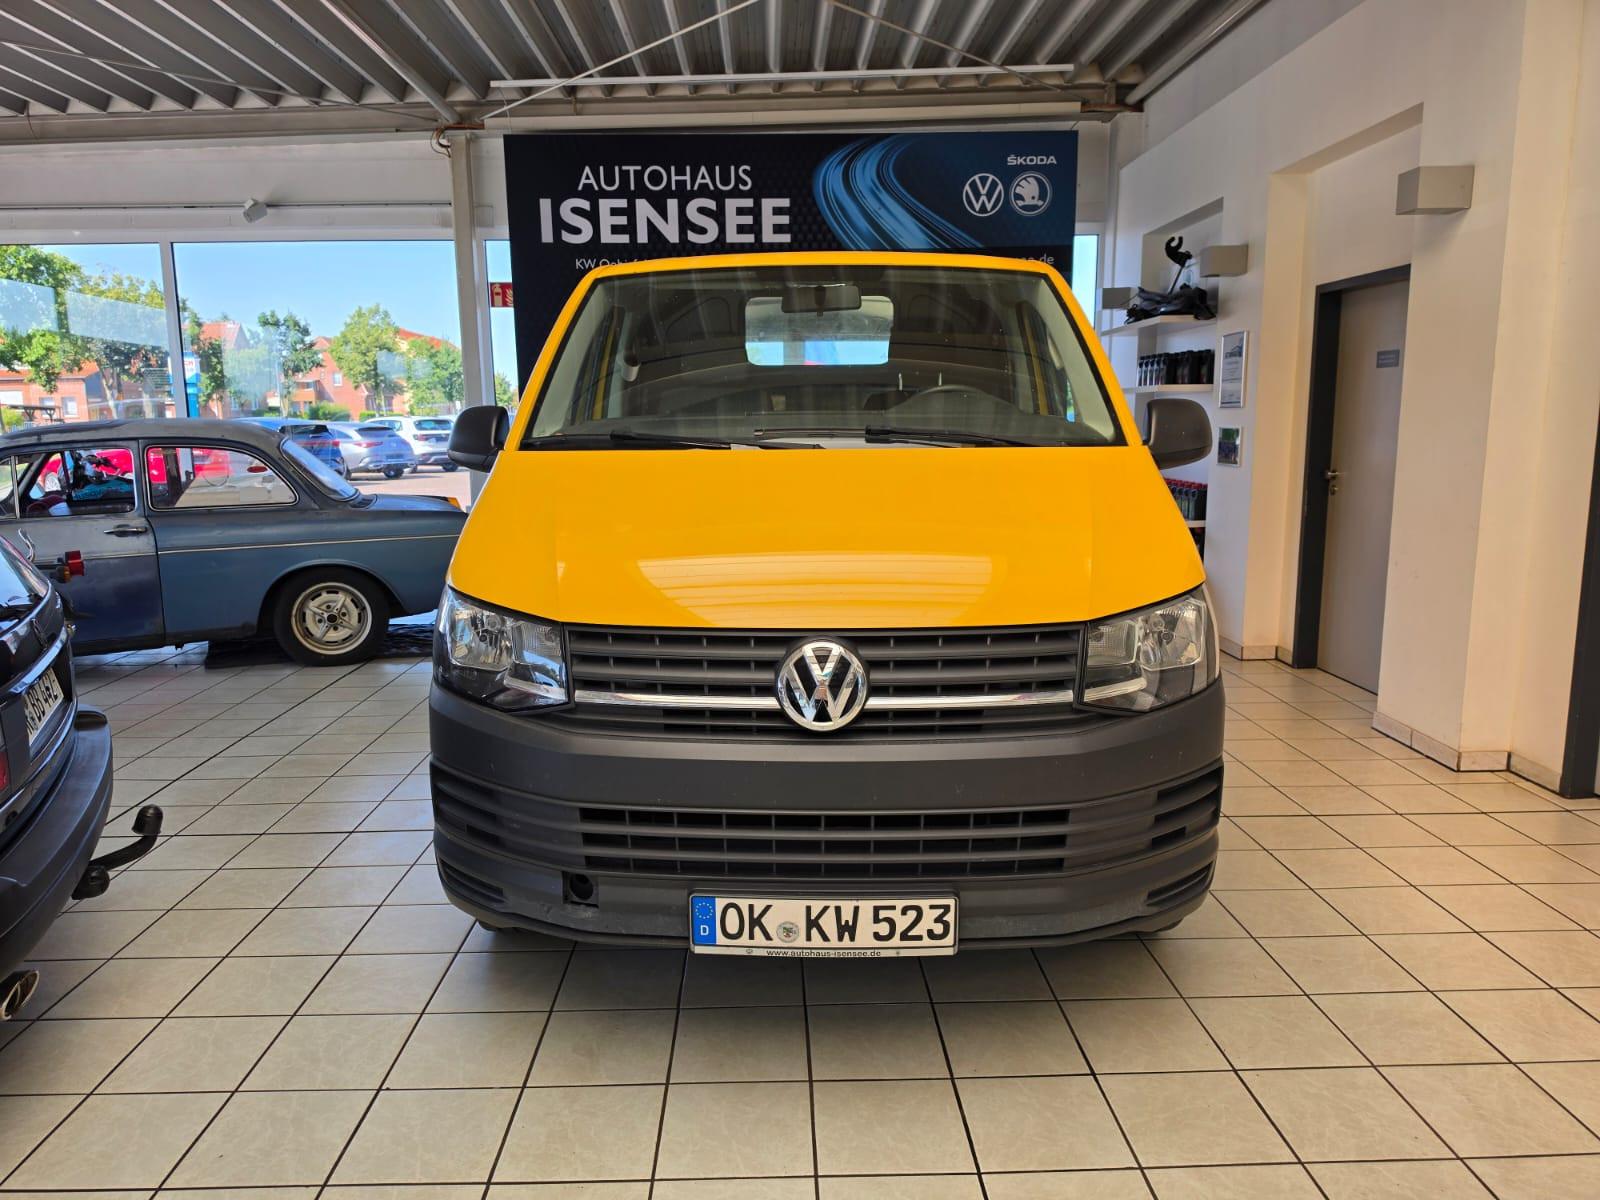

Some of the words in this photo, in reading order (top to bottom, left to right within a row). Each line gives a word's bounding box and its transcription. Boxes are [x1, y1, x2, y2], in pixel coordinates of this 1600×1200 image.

[1007, 154, 1057, 166] ŠKODA
[577, 164, 753, 192] AUTOHAUS
[963, 173, 1004, 216] VW
[539, 197, 792, 244] ISENSEE
[575, 258, 597, 269] KW
[778, 641, 867, 731] VW
[700, 925, 709, 936] D
[720, 902, 774, 942] OK
[805, 904, 860, 942] KW
[872, 904, 951, 942] 523
[766, 949, 881, 957] www.autohaus-isensee.de
